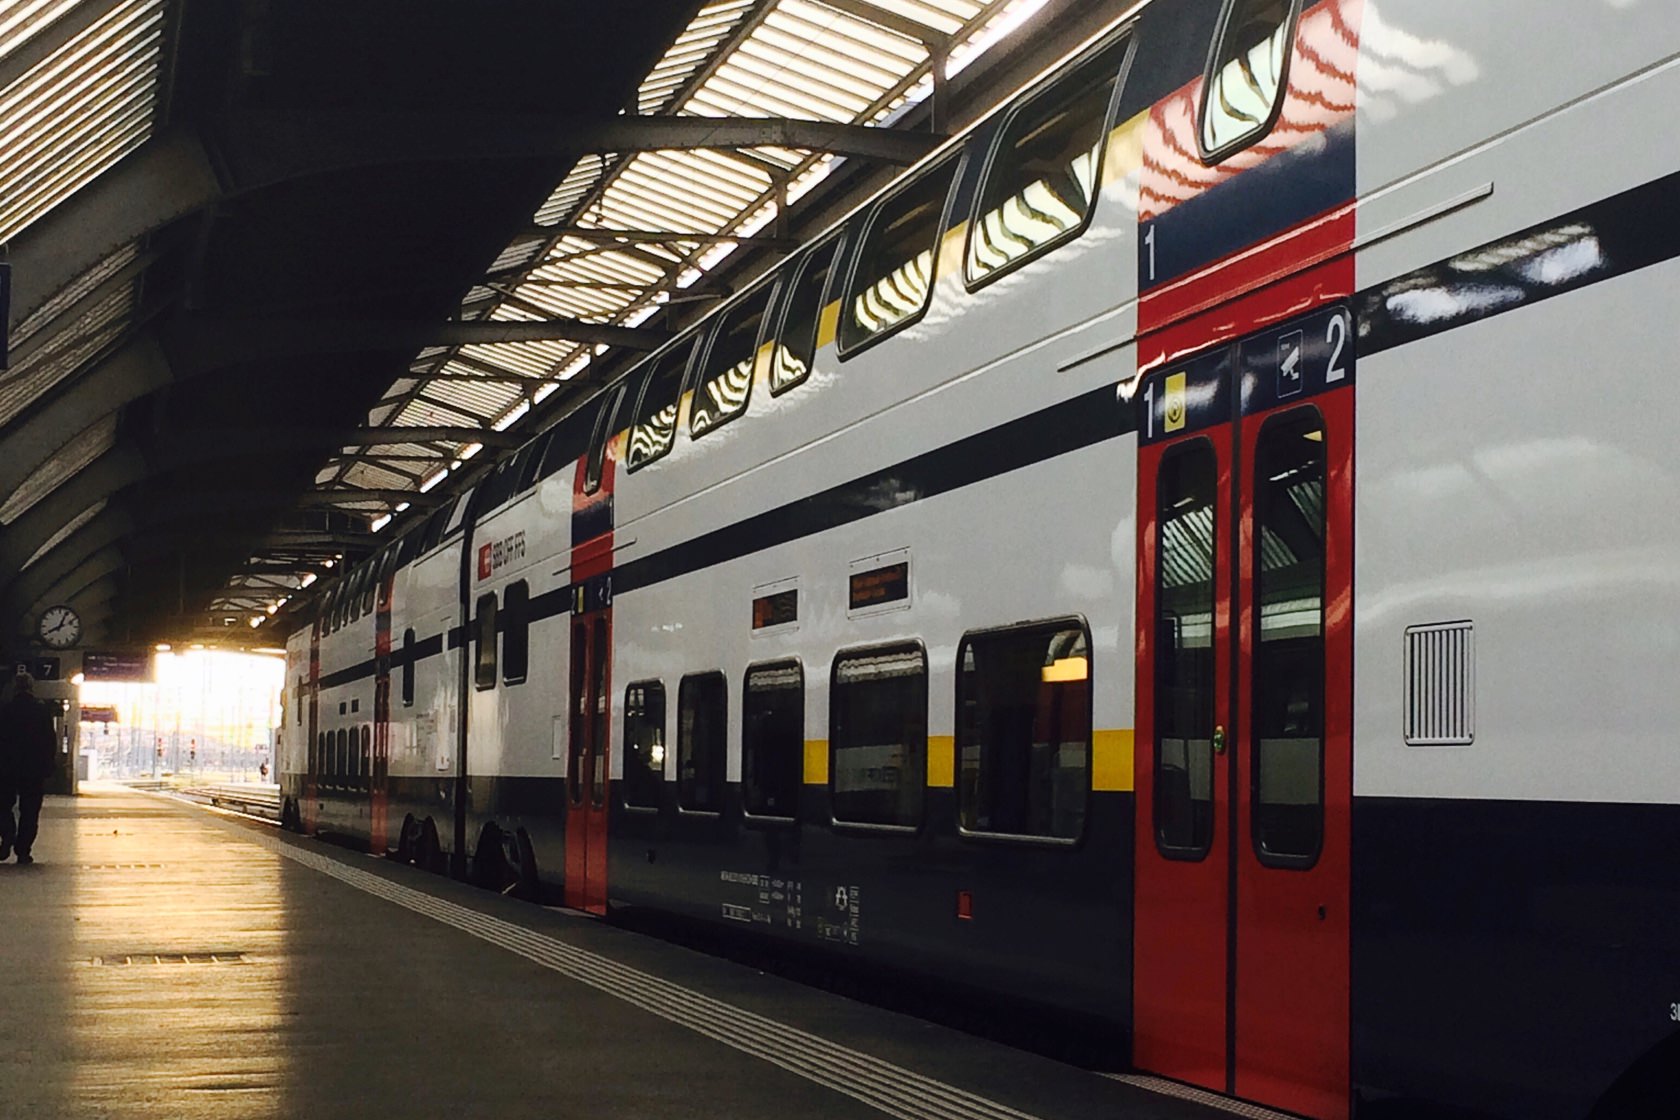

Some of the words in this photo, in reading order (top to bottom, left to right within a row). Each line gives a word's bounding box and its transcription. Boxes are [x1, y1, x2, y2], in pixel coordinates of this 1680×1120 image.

[1145, 224, 1155, 280] 1
[1325, 314, 1346, 384] 2
[1143, 382, 1154, 438] 1
[43, 664, 52, 676] 7
